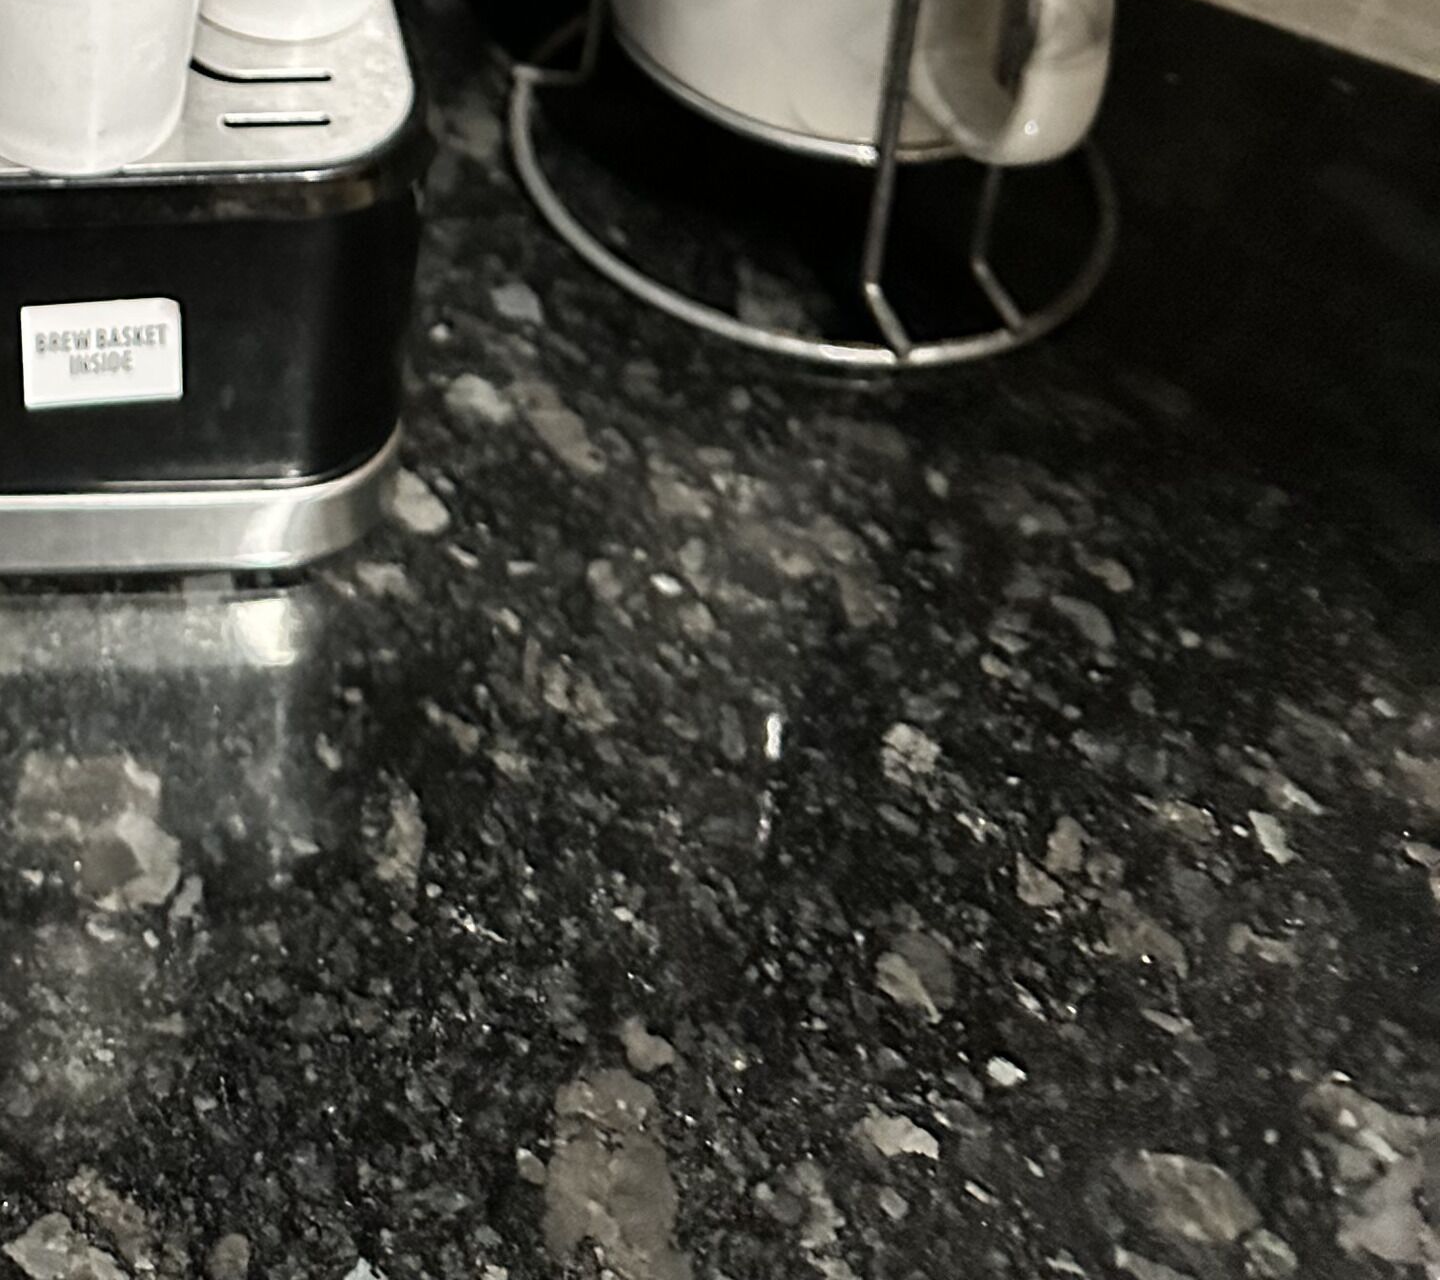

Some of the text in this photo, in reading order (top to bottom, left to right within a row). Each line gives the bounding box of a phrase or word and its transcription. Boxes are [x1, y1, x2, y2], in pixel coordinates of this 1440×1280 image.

[35, 322, 168, 354] BREW BASKET
[69, 350, 134, 375] INSIDE
